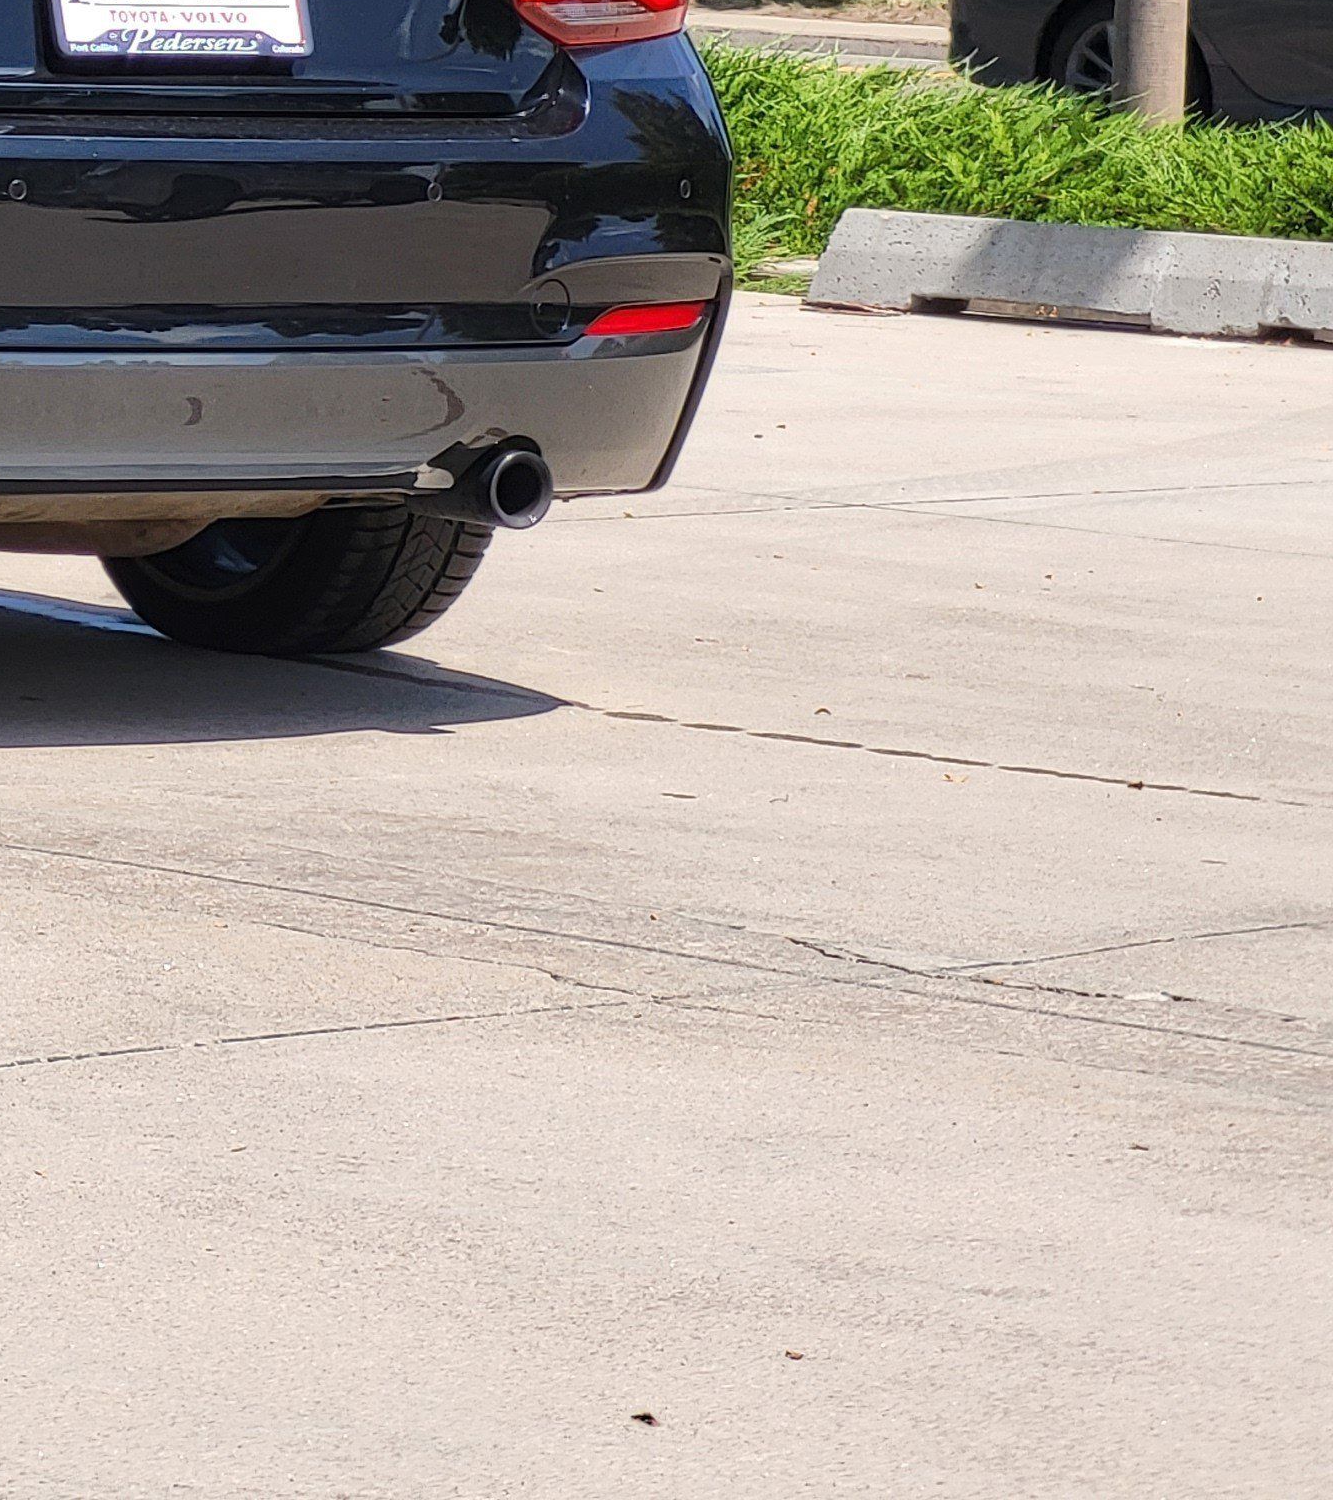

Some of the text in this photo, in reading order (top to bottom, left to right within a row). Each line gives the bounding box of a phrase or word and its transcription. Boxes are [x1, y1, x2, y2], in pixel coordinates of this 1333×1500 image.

[110, 10, 247, 24] TOYOTA VOLVO
[120, 28, 258, 52] Pedersen
